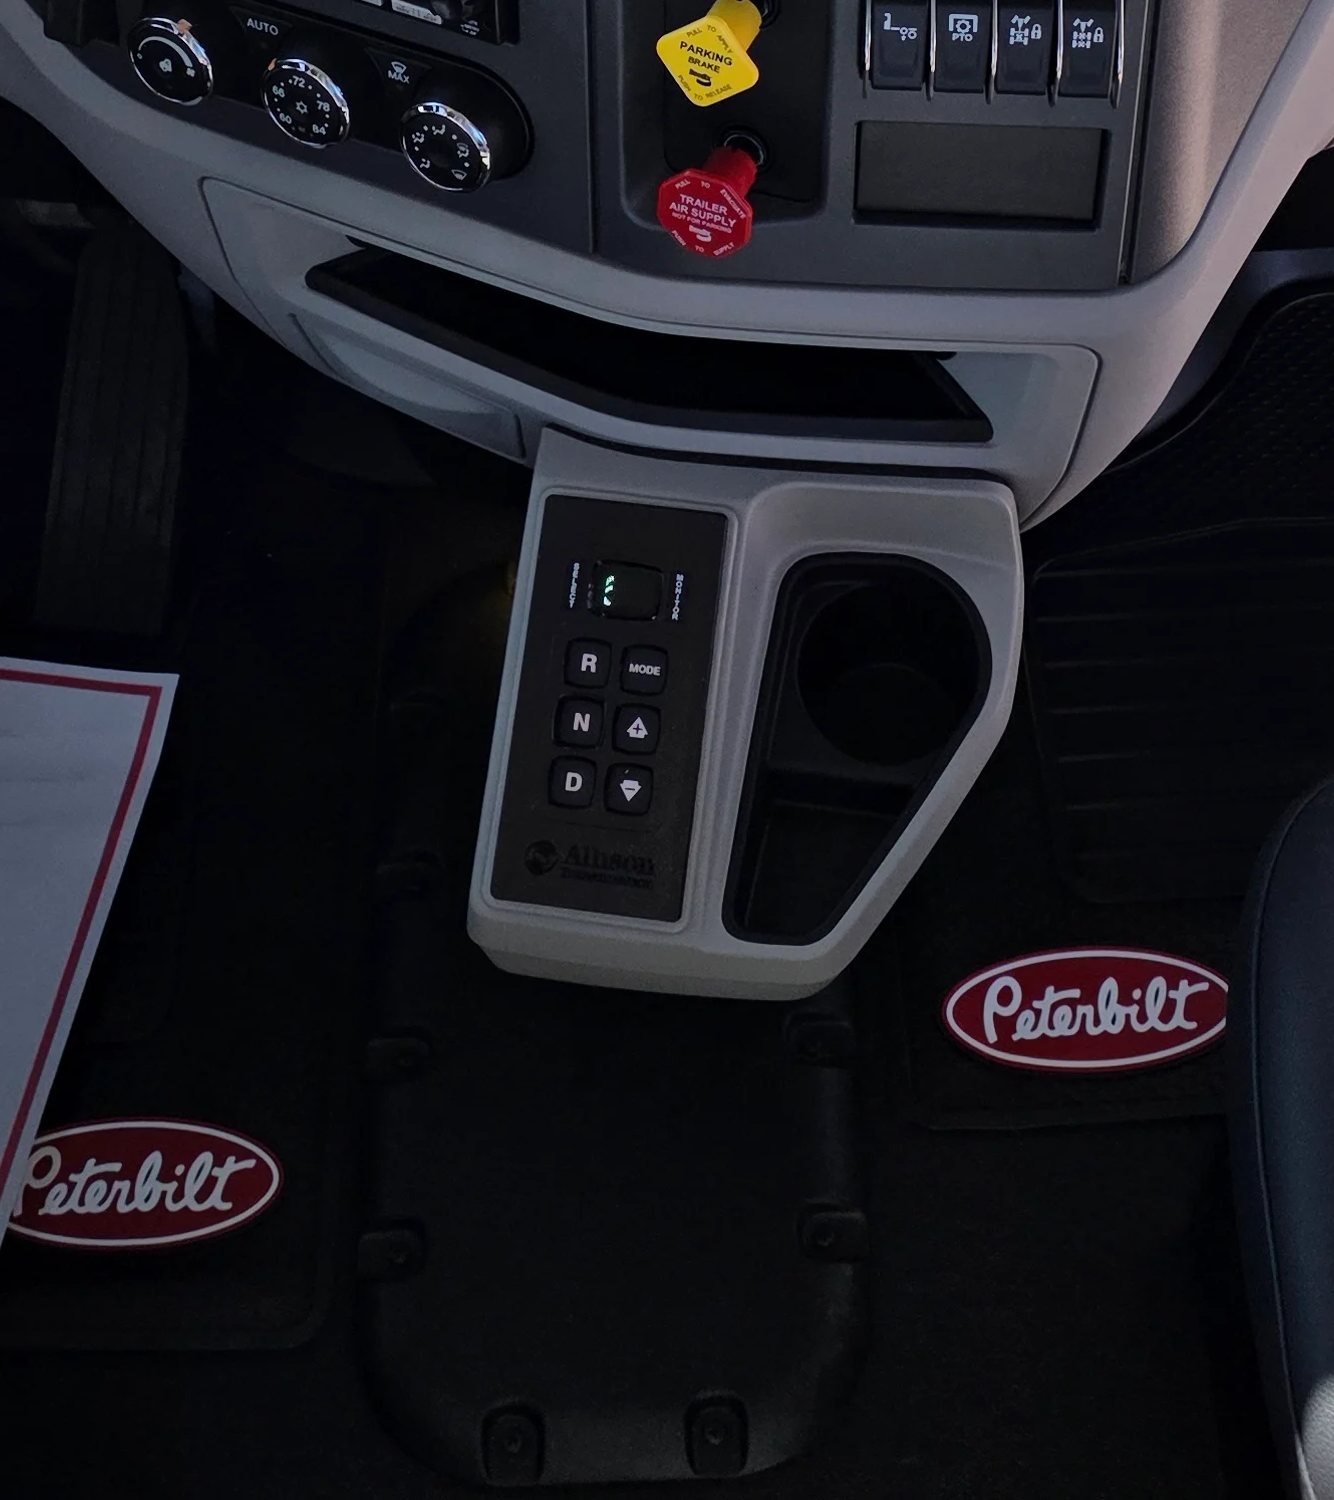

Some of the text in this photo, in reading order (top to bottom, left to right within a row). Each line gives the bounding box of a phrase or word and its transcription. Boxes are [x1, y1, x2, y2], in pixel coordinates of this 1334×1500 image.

[246, 17, 279, 36] AUTO
[686, 27, 703, 38] PULL
[707, 25, 716, 33] TO
[951, 32, 974, 42] PTO
[679, 41, 733, 66] PARKING
[687, 55, 721, 74] BRAKE
[292, 75, 305, 88] 72
[387, 69, 410, 85] MAX
[272, 85, 285, 98] 66
[693, 93, 704, 101] TO
[704, 84, 732, 99] RELEASE
[316, 100, 331, 112] 78
[279, 113, 292, 125] 60
[312, 124, 327, 135] 84
[674, 180, 691, 190] PULL
[701, 181, 711, 189] TO
[679, 194, 728, 216] TRAILER
[669, 202, 737, 228] AIR SUPPLY
[672, 211, 686, 220] NOT
[687, 216, 701, 224] FOR
[695, 245, 705, 253] TO
[671, 573, 685, 621] MONITOR
[580, 653, 598, 673] R
[628, 663, 662, 676] MODE
[572, 712, 591, 732] N
[564, 771, 583, 792] D
[983, 975, 1210, 1044] Peterbilt
[13, 1145, 257, 1217] Peterbilt
